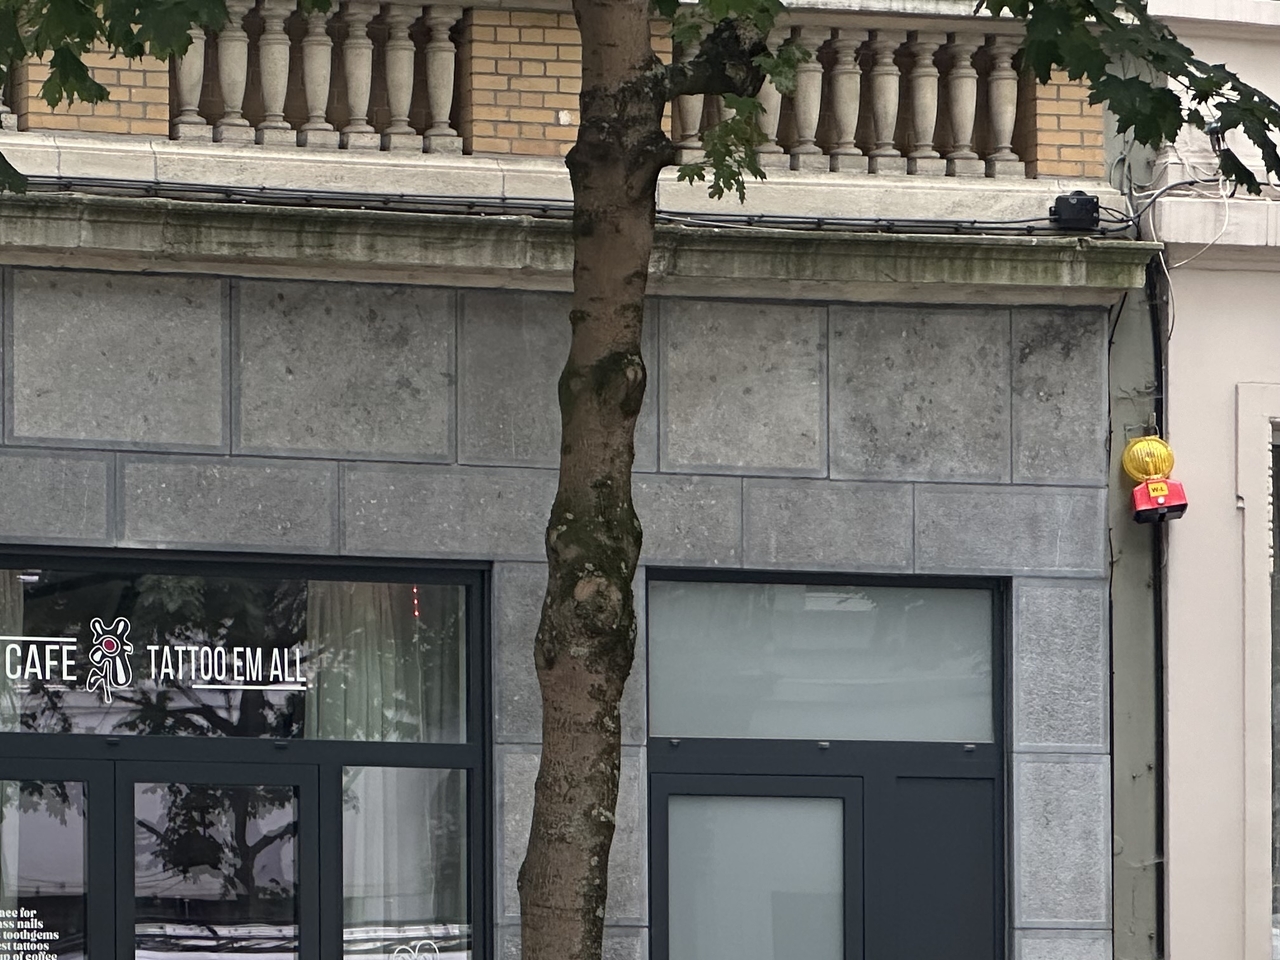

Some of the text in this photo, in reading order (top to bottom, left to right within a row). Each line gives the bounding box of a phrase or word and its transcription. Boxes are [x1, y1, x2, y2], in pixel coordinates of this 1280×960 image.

[5, 643, 77, 681] CAFE
[147, 645, 307, 682] TATTOO EM ALL
[20, 907, 37, 918] for
[17, 918, 44, 929] nails
[3, 929, 59, 941] toothgems
[12, 941, 49, 951] tattoos
